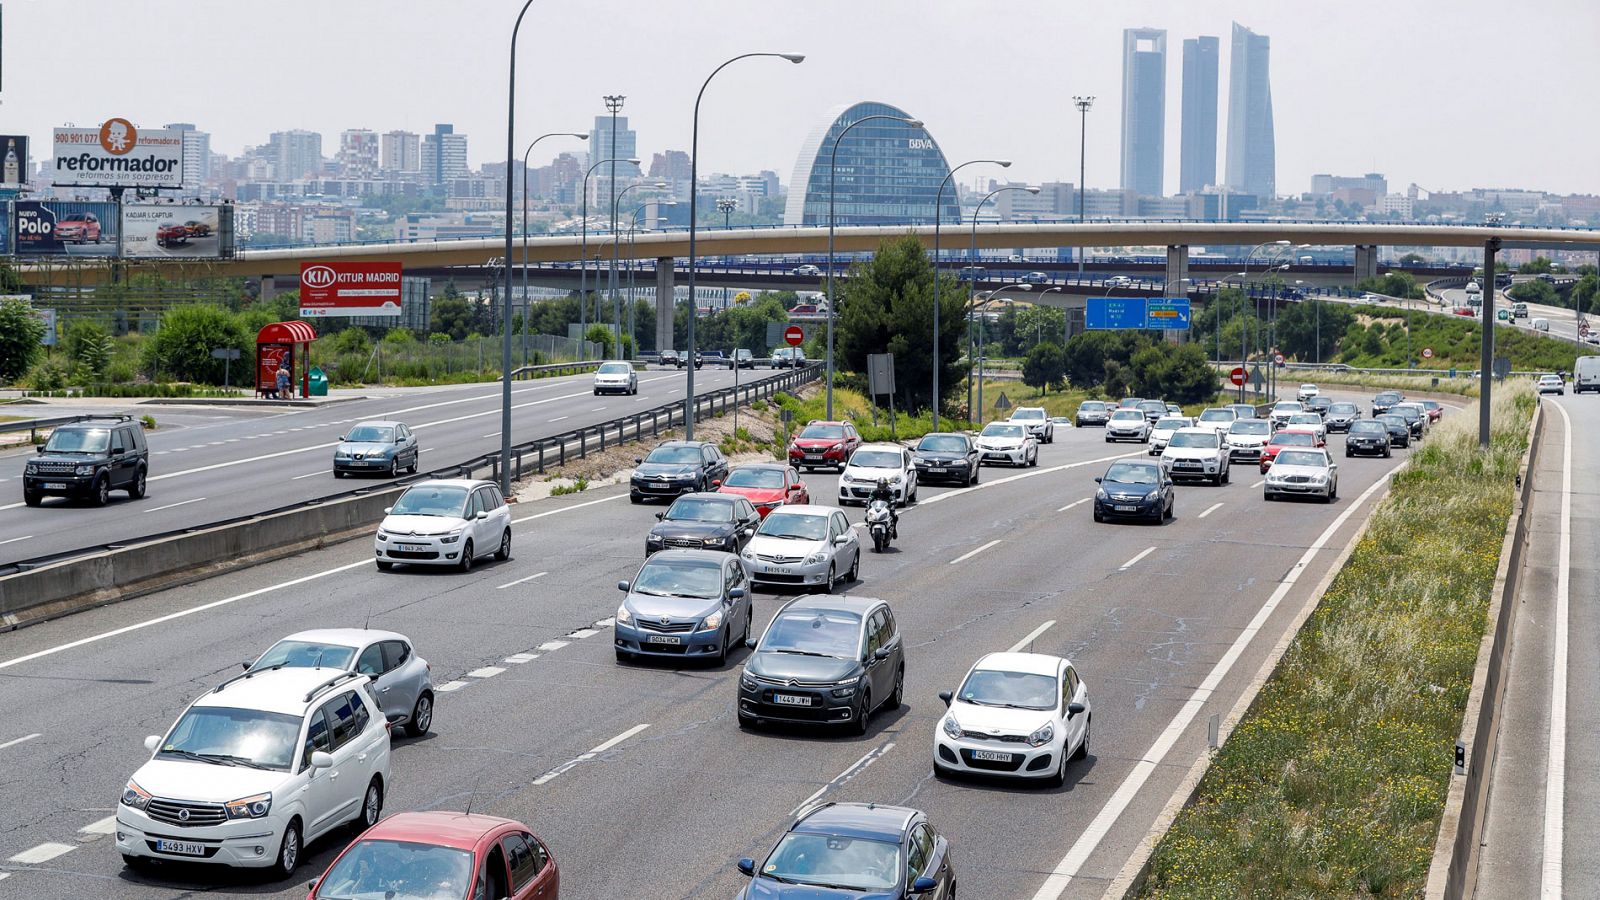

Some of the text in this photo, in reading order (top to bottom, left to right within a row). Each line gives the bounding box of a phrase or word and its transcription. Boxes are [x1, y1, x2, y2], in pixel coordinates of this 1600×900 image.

[55, 134, 98, 143] 900 901 077
[138, 136, 180, 145] reformador.es
[909, 139, 933, 149] BBVA
[57, 153, 178, 172] reformador
[77, 171, 174, 181] reformas sin sorpresas
[18, 217, 51, 234] Polo
[308, 271, 399, 283] KIA KITUR MADRID
[779, 695, 795, 704] 1449
[977, 751, 1011, 761] 4500 HHY
[162, 841, 203, 854] 5493 HXV
